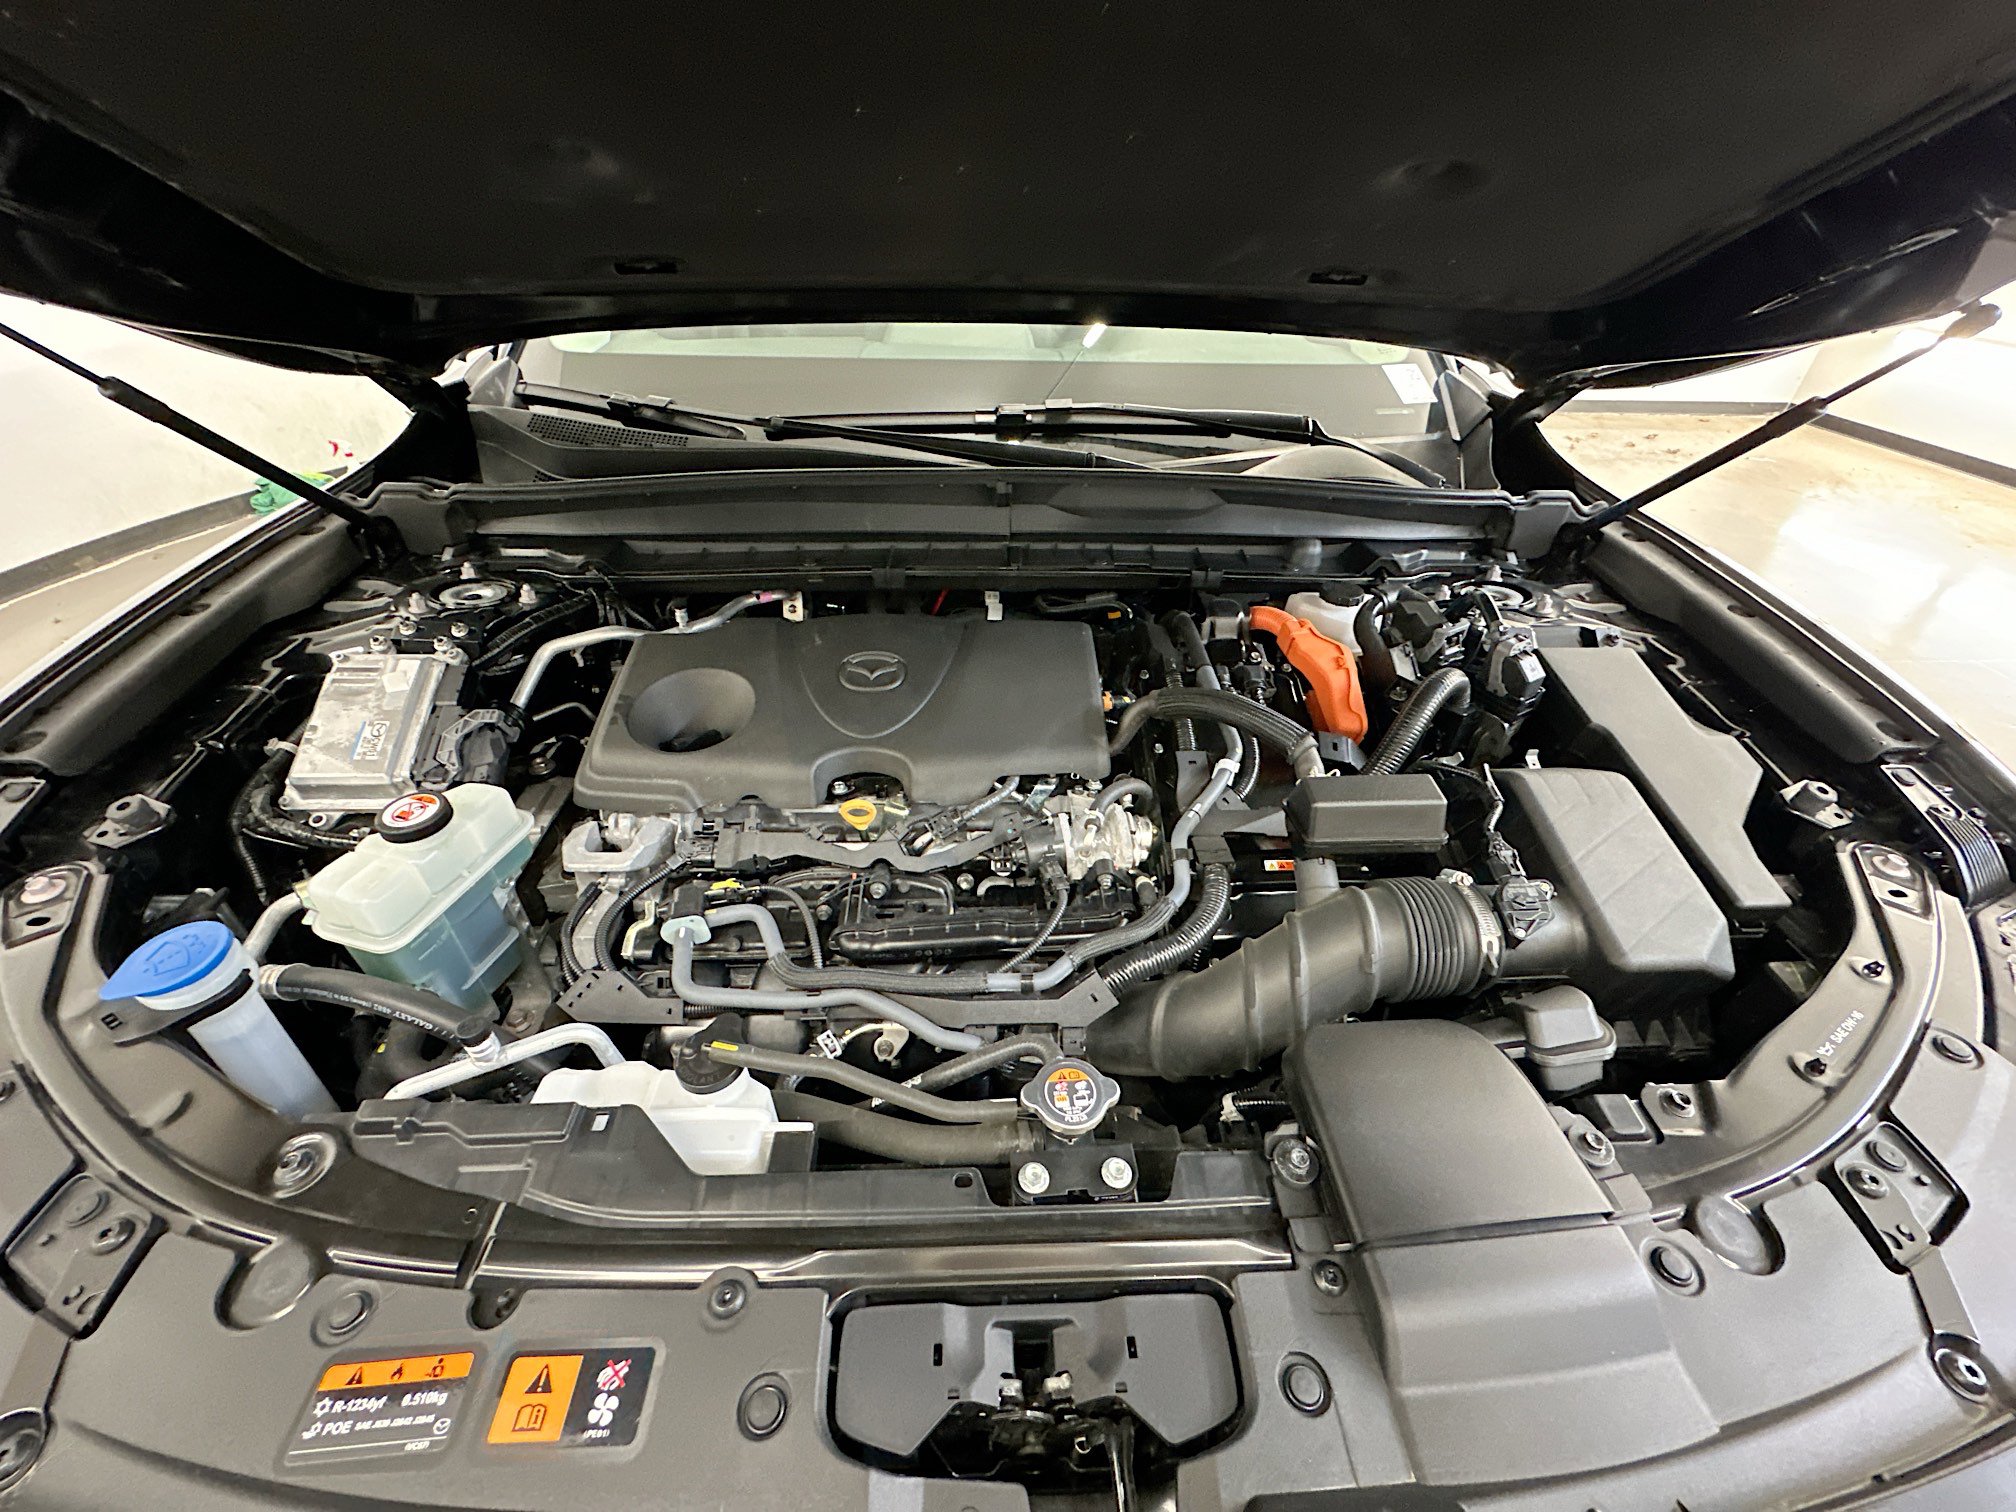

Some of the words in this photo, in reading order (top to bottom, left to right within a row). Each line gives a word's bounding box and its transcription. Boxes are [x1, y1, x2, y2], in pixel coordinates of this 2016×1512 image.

[1829, 1027, 1849, 1043] SAE
[331, 1395, 387, 1413] R-1234yf
[321, 1420, 354, 1436] POE
